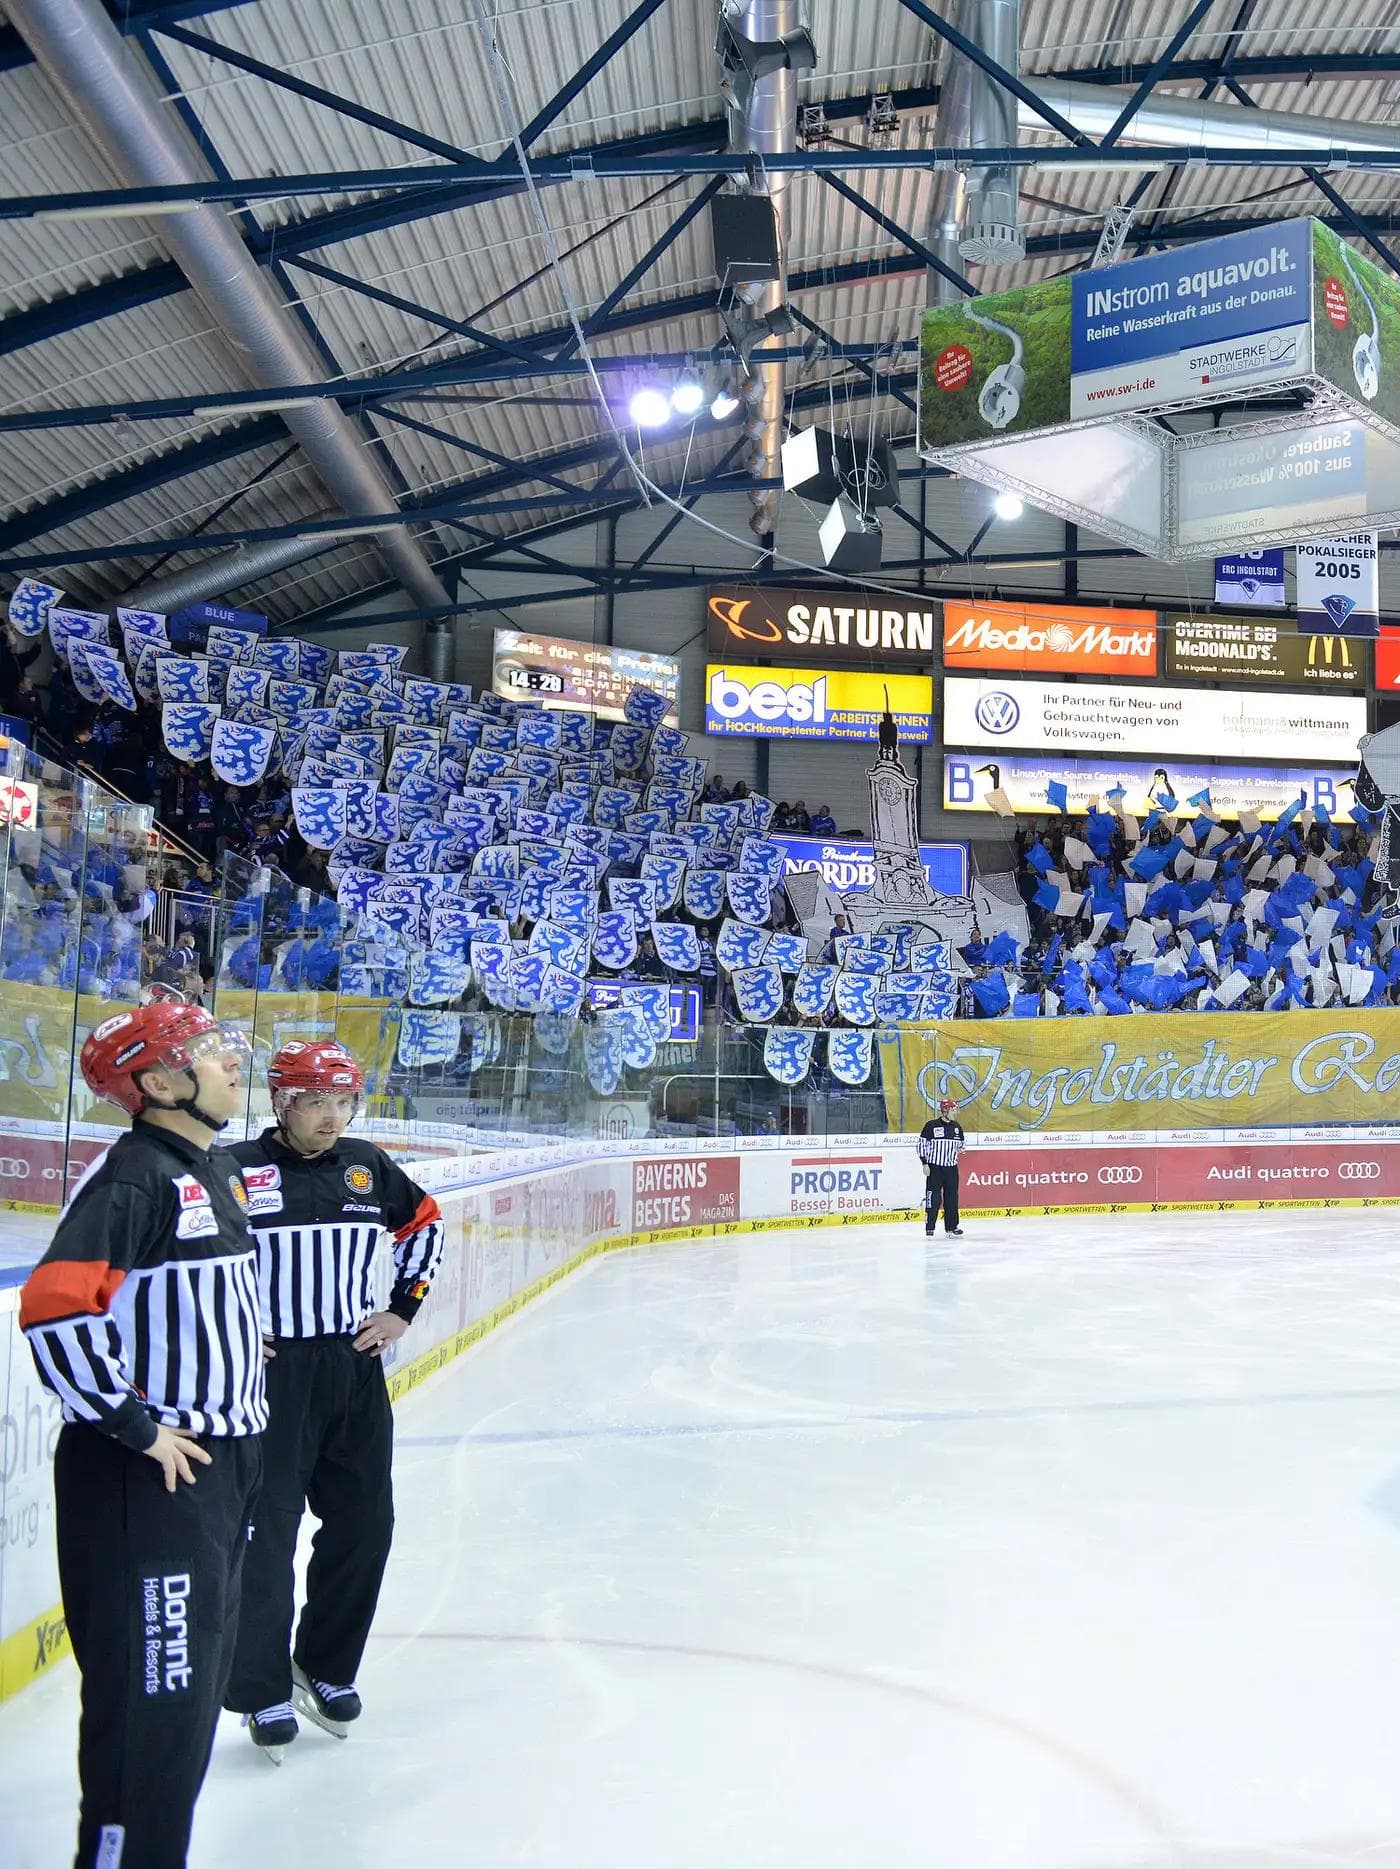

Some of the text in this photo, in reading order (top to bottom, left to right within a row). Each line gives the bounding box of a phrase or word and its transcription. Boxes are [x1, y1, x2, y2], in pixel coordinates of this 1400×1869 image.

[1087, 247, 1296, 317] INstrom aquavolt.
[1087, 284, 1296, 342] Reine Wasserkraft aus der Donau.
[1189, 344, 1266, 370] STADTWERKE
[1209, 356, 1266, 375] INGOLSTADT
[1087, 378, 1156, 401] www.sw-i.de
[1298, 545, 1376, 560] POKALSIEGER
[1236, 565, 1278, 577] INGOLSTADT
[1314, 561, 1361, 579] 2005
[204, 605, 236, 622] BLUE
[786, 604, 933, 651] SATURN
[1175, 621, 1278, 643] OVERTIME BEI
[502, 636, 544, 655] Zeit
[548, 645, 578, 660] für
[584, 652, 612, 666] die
[1319, 668, 1341, 679] liebe
[1043, 694, 1182, 711] Ihr Partner für Neu- und
[1043, 709, 1179, 728] Gebrauchtwagen von
[708, 719, 867, 739] Ihr HOCHkompetenter Partner
[1043, 726, 1125, 742] Volkswagen.
[1063, 771, 1093, 781] Source
[1211, 776, 1244, 788] Support
[917, 1036, 1279, 1130] Ingolstädter
[835, 1137, 852, 1145] Audi
[1043, 1134, 1062, 1142] Audi
[1238, 1131, 1257, 1139] Audi
[635, 1161, 709, 1194] BAYERNS
[791, 1168, 883, 1195] PROBAT
[966, 1168, 1089, 1188] Audi quattro
[1206, 1163, 1330, 1183] Audi quattro
[719, 1193, 735, 1206] DAS
[791, 1195, 884, 1212] Besser Bauen.
[1171, 1203, 1214, 1211] SPORTWETTEN
[635, 1195, 692, 1227] BESTES
[701, 1207, 735, 1221] MAGAZIN
[960, 1209, 1001, 1218] SPORTWETTEN
[768, 1219, 804, 1230] SPORTWETTEN
[143, 1577, 160, 1696] Hotels & Resorts
[163, 1572, 191, 1693] Dorint
